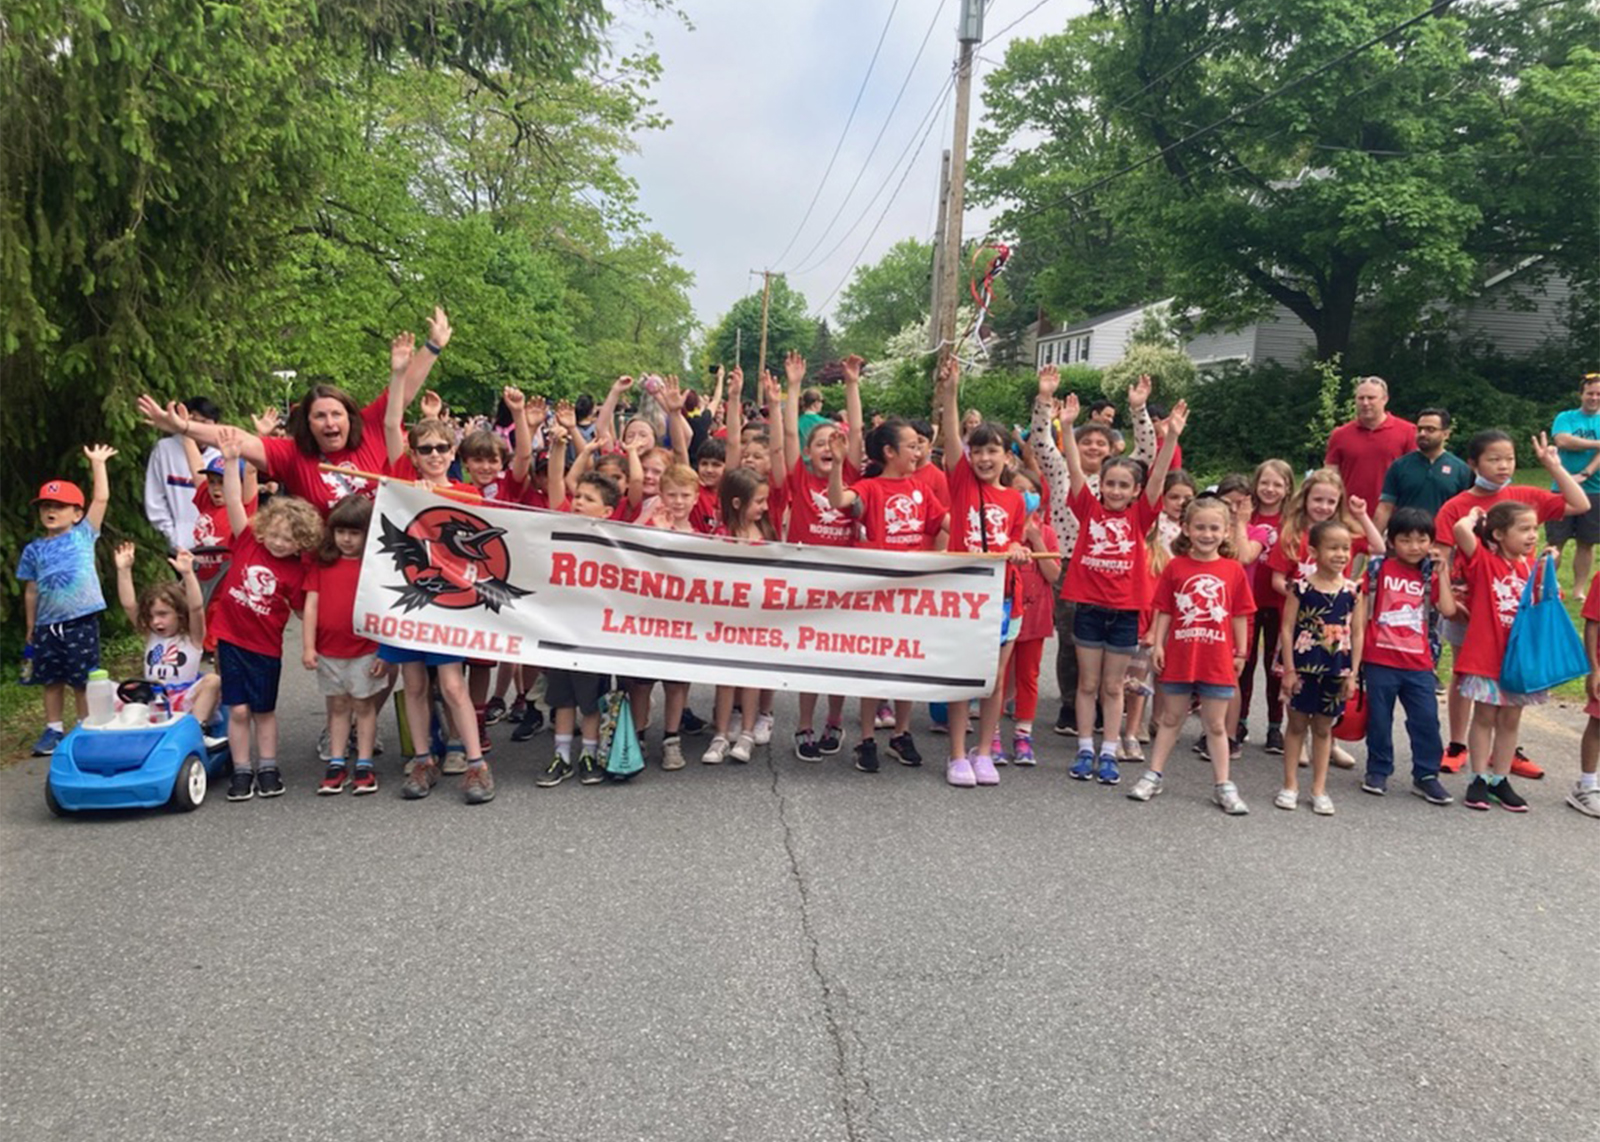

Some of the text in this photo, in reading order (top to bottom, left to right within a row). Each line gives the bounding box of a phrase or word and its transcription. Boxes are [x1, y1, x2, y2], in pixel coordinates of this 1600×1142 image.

[549, 552, 990, 620] ROSENDALE ELEMENTARY
[363, 613, 523, 655] ROSENDALE
[602, 608, 926, 660] LAUREL JONES, PRINCIPAL
